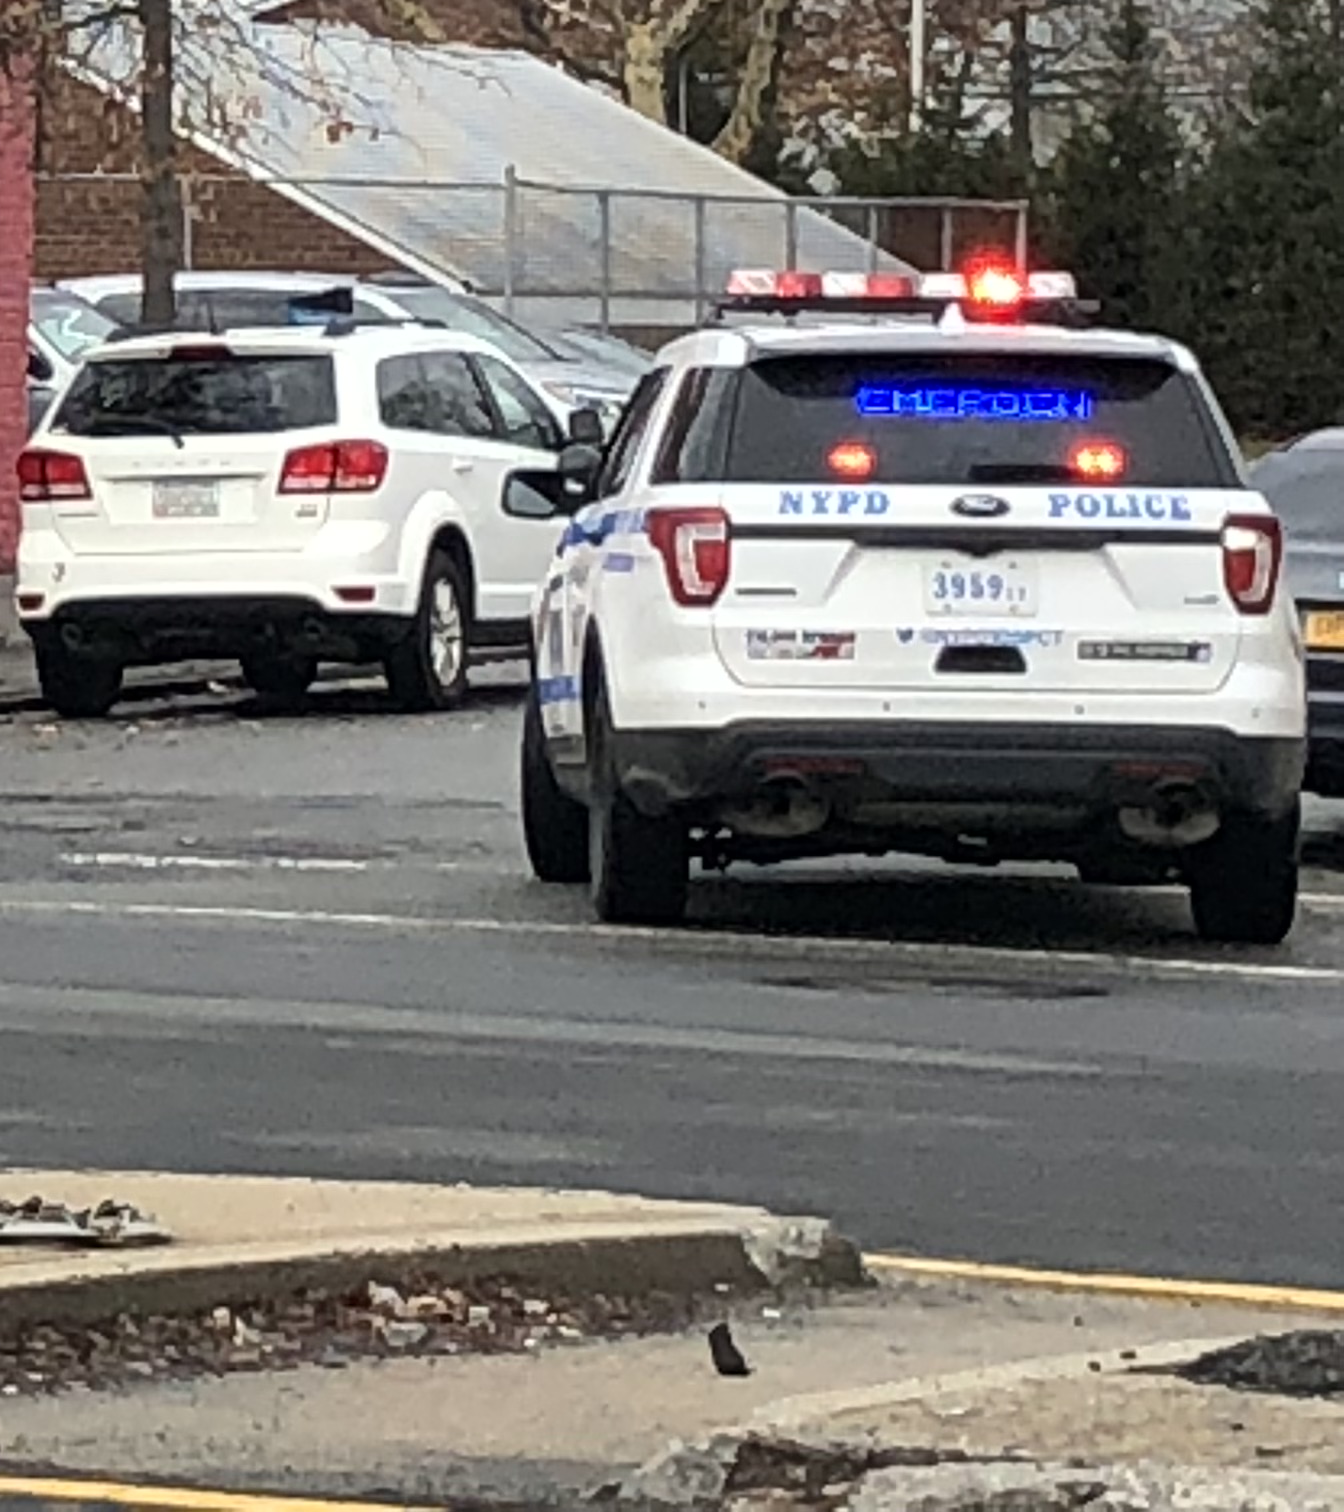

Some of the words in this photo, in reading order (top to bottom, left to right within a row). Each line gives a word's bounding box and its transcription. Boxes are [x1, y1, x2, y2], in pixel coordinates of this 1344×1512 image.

[777, 490, 891, 516] NYPD
[1046, 493, 1193, 521] POLICE
[932, 571, 1004, 602] 3959
